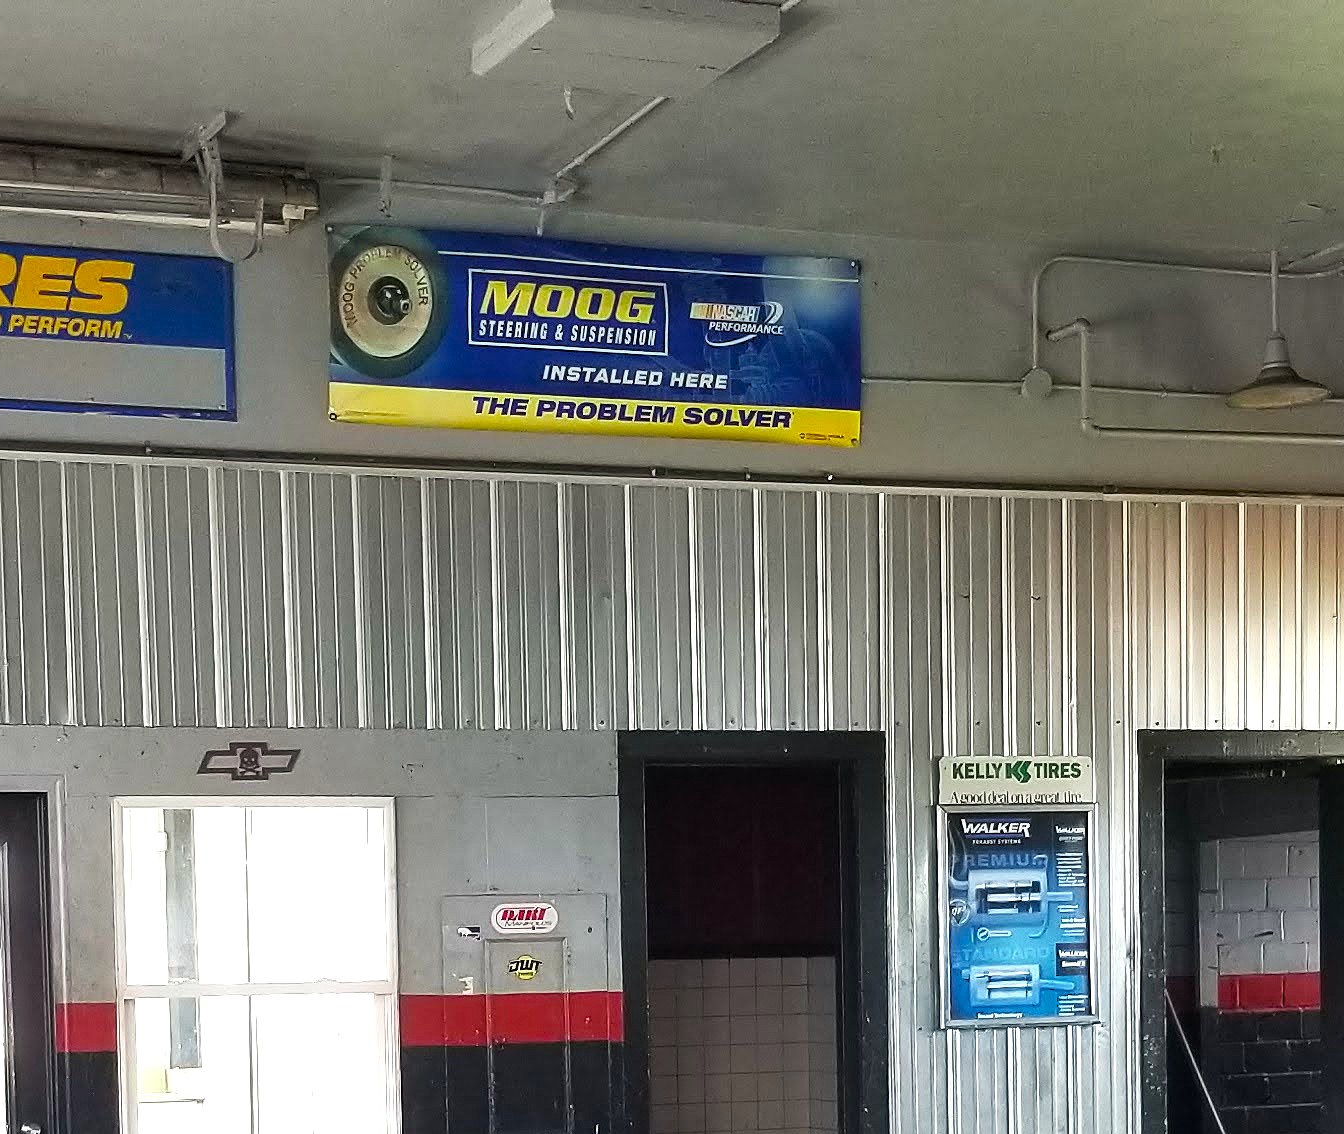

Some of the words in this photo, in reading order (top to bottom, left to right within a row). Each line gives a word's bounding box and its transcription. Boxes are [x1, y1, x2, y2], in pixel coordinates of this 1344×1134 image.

[404, 254, 430, 306] SOLVER
[479, 280, 656, 324] MOOG
[8, 315, 123, 340] PERFORM
[479, 319, 548, 340] STEERING
[555, 324, 564, 341] &
[570, 325, 657, 346] SUSPENSION
[708, 321, 784, 335] PERFORMANCE
[542, 364, 663, 386] INSTALLED
[669, 371, 729, 389] HERE
[473, 396, 529, 417] THE
[536, 400, 676, 424] PROBLEM
[682, 407, 792, 428] SOLVER
[952, 762, 1002, 779] KELLY
[1033, 762, 1082, 779] TIRES
[961, 819, 1031, 838] WALKER
